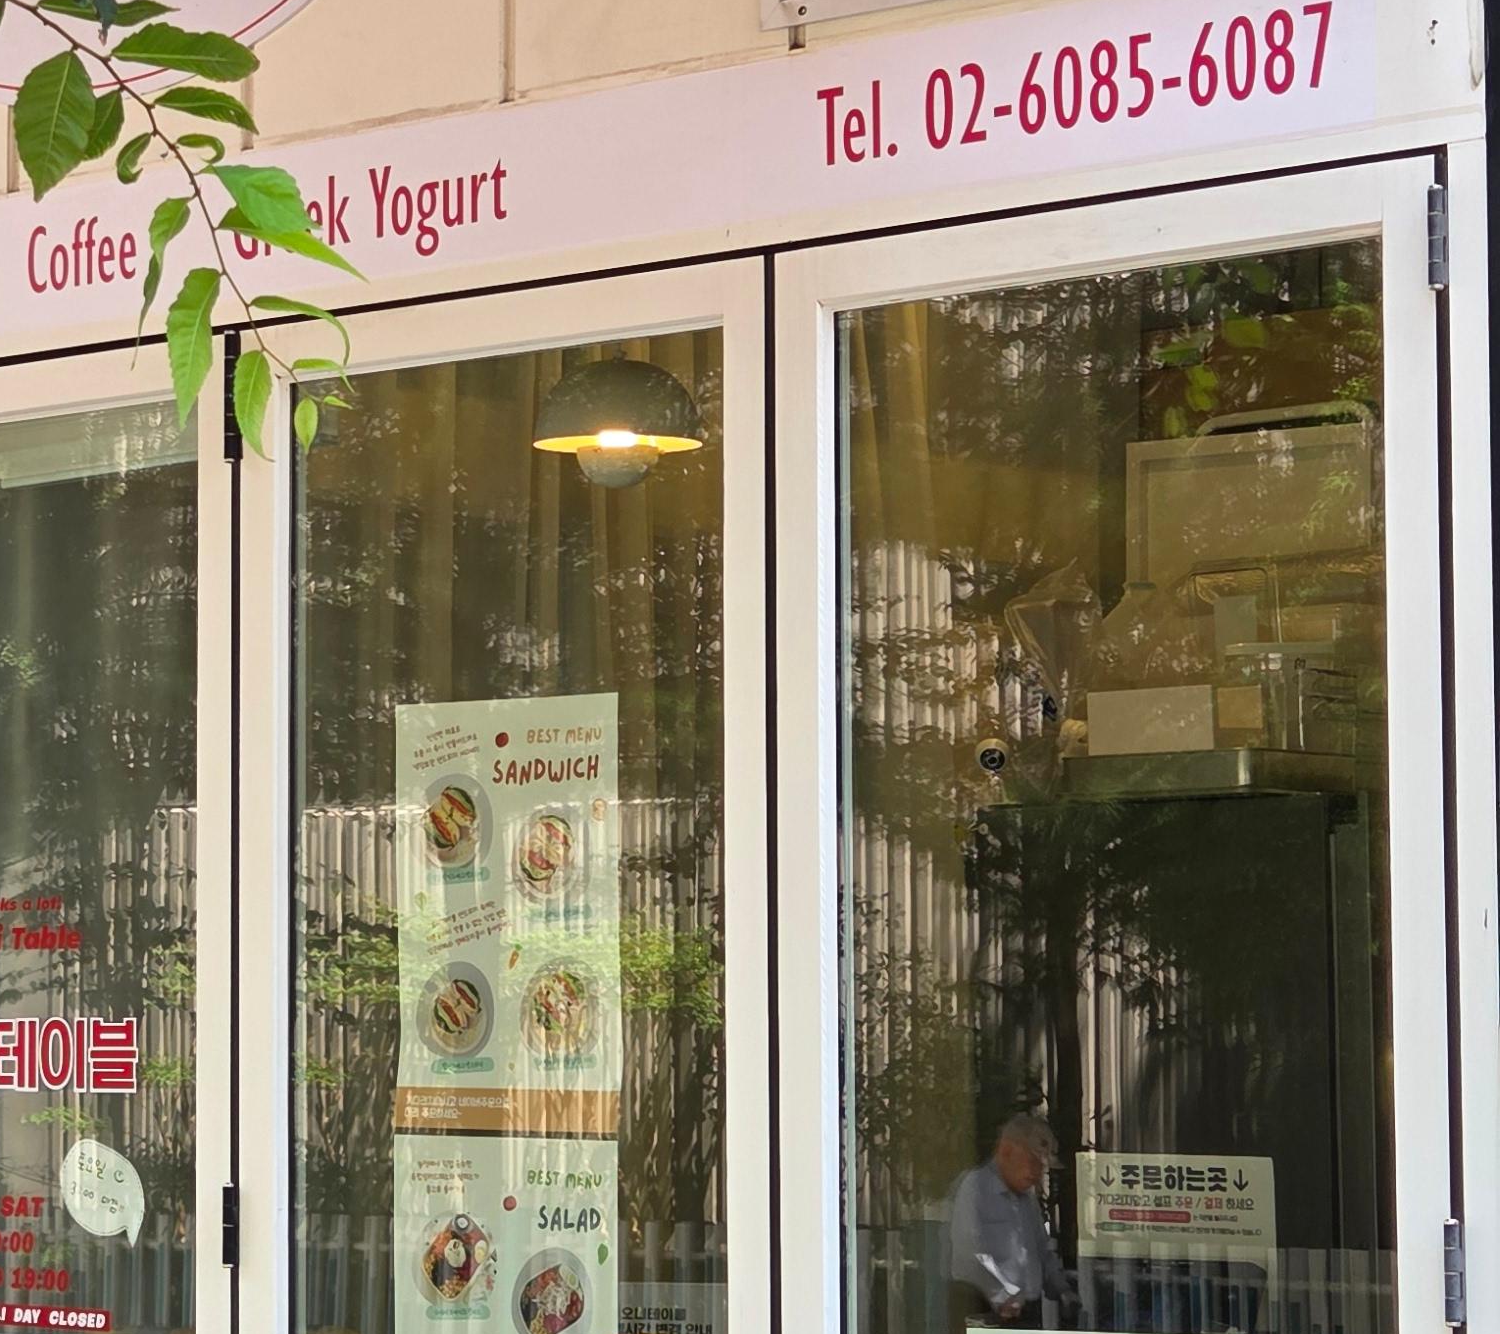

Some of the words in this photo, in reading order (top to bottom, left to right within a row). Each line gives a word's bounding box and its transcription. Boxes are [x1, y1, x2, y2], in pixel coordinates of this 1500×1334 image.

[817, 80, 899, 166] Tel.
[924, 0, 1333, 150] 02-6085-6087
[368, 158, 508, 257] Yogurt
[28, 216, 137, 294] Coffee
[527, 728, 560, 744] BEST
[565, 726, 602, 744] MENU
[492, 754, 599, 786] SANDWICH
[22, 899, 32, 911] a
[12, 924, 82, 951] Table
[527, 1169, 560, 1186] BEST
[565, 1170, 602, 1188] MENU
[1121, 1164, 1228, 1192] 주문하는곳
[1, 1196, 45, 1218] SAT
[537, 1205, 600, 1233] SALAD
[11, 1267, 70, 1293] 19:00
[13, 1308, 42, 1325] DAY
[48, 1310, 107, 1329] CLOSED
